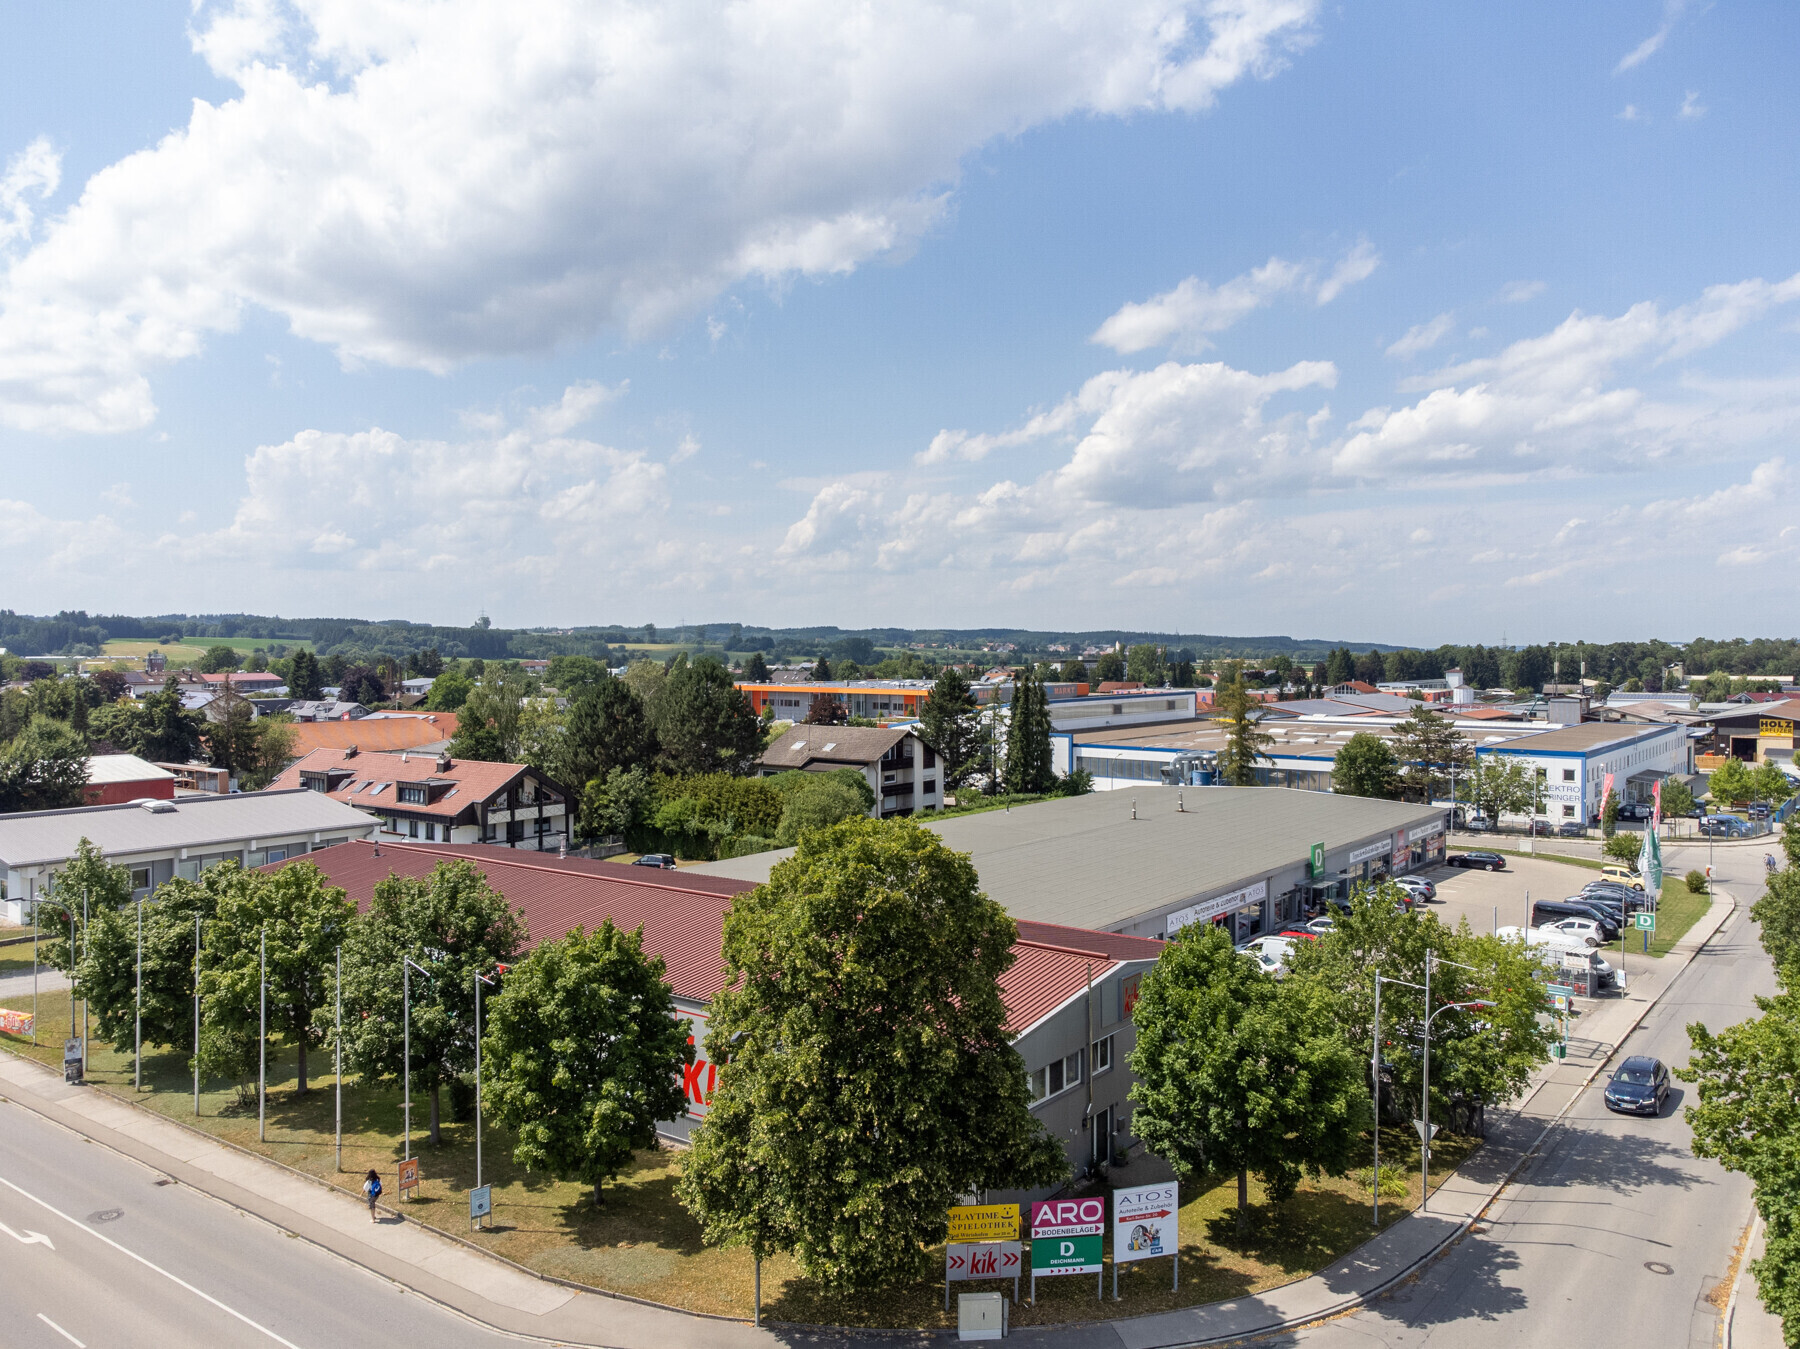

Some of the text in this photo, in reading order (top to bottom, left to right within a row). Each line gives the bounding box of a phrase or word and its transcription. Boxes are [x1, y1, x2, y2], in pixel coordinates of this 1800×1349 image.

[1315, 848, 1322, 866] D
[1169, 914, 1189, 926] ATOS
[1248, 886, 1264, 897] ATOS
[1639, 916, 1652, 926] D
[1119, 1190, 1173, 1206] ATOS
[952, 1212, 999, 1221] PLAYTIME
[1034, 1201, 1102, 1226] ARO
[951, 1222, 1014, 1231] SPIELOTHEK
[1041, 1226, 1094, 1236] BODENBELÄGE
[1060, 1242, 1075, 1257] D
[970, 1248, 998, 1275] kik
